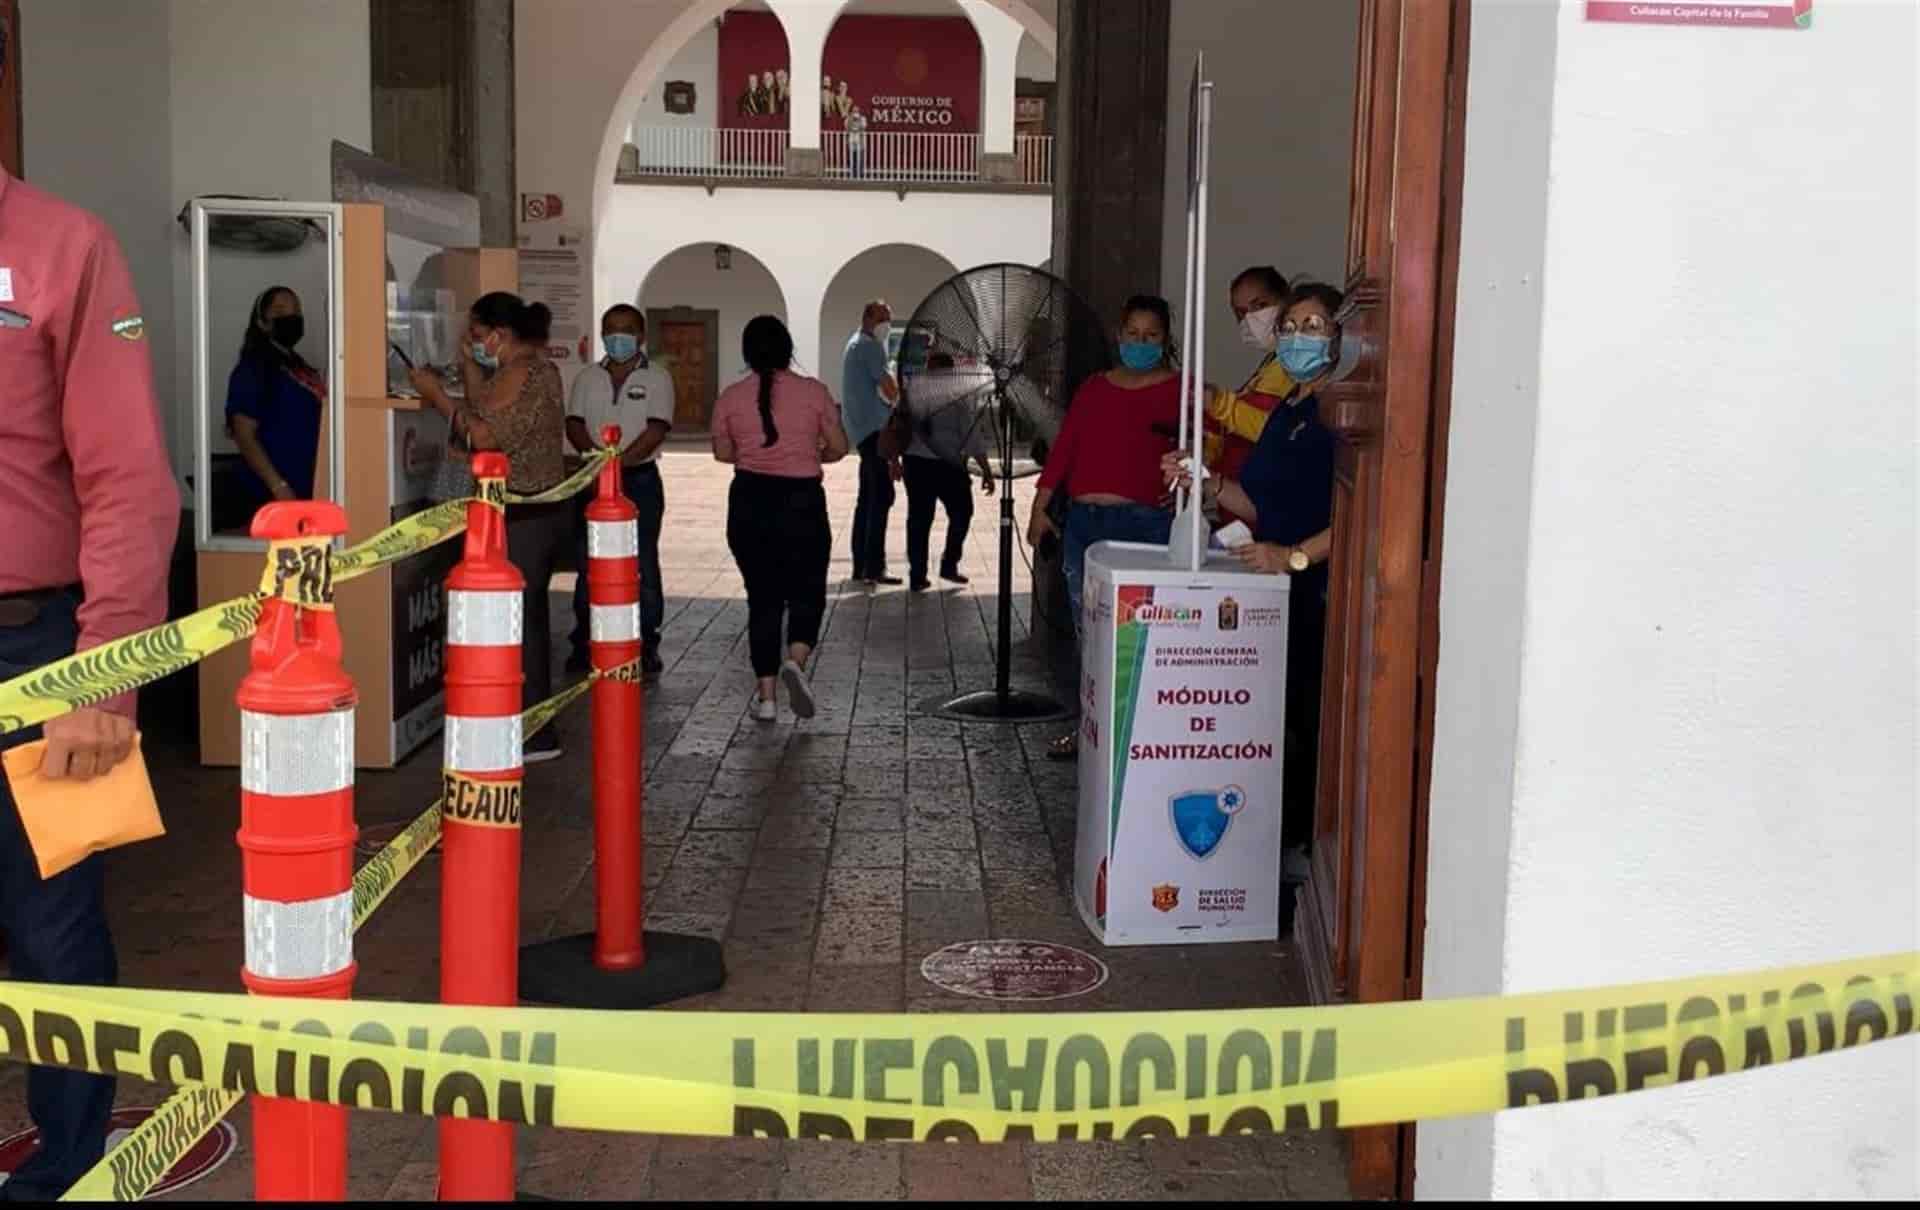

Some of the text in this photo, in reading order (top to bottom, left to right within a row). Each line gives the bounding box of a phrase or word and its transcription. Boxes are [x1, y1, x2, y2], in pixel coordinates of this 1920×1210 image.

[872, 95, 952, 108] GOBIERNO DE
[872, 105, 953, 125] MÉXICO
[1155, 645, 1258, 657] DIRECCIÓN GENERAL
[1155, 656, 1259, 667] DE ADMINISTRACIÓN
[1157, 685, 1251, 705] MÓDULO
[1190, 717, 1217, 732] DE
[1130, 739, 1273, 760] SANITIZACIÓN
